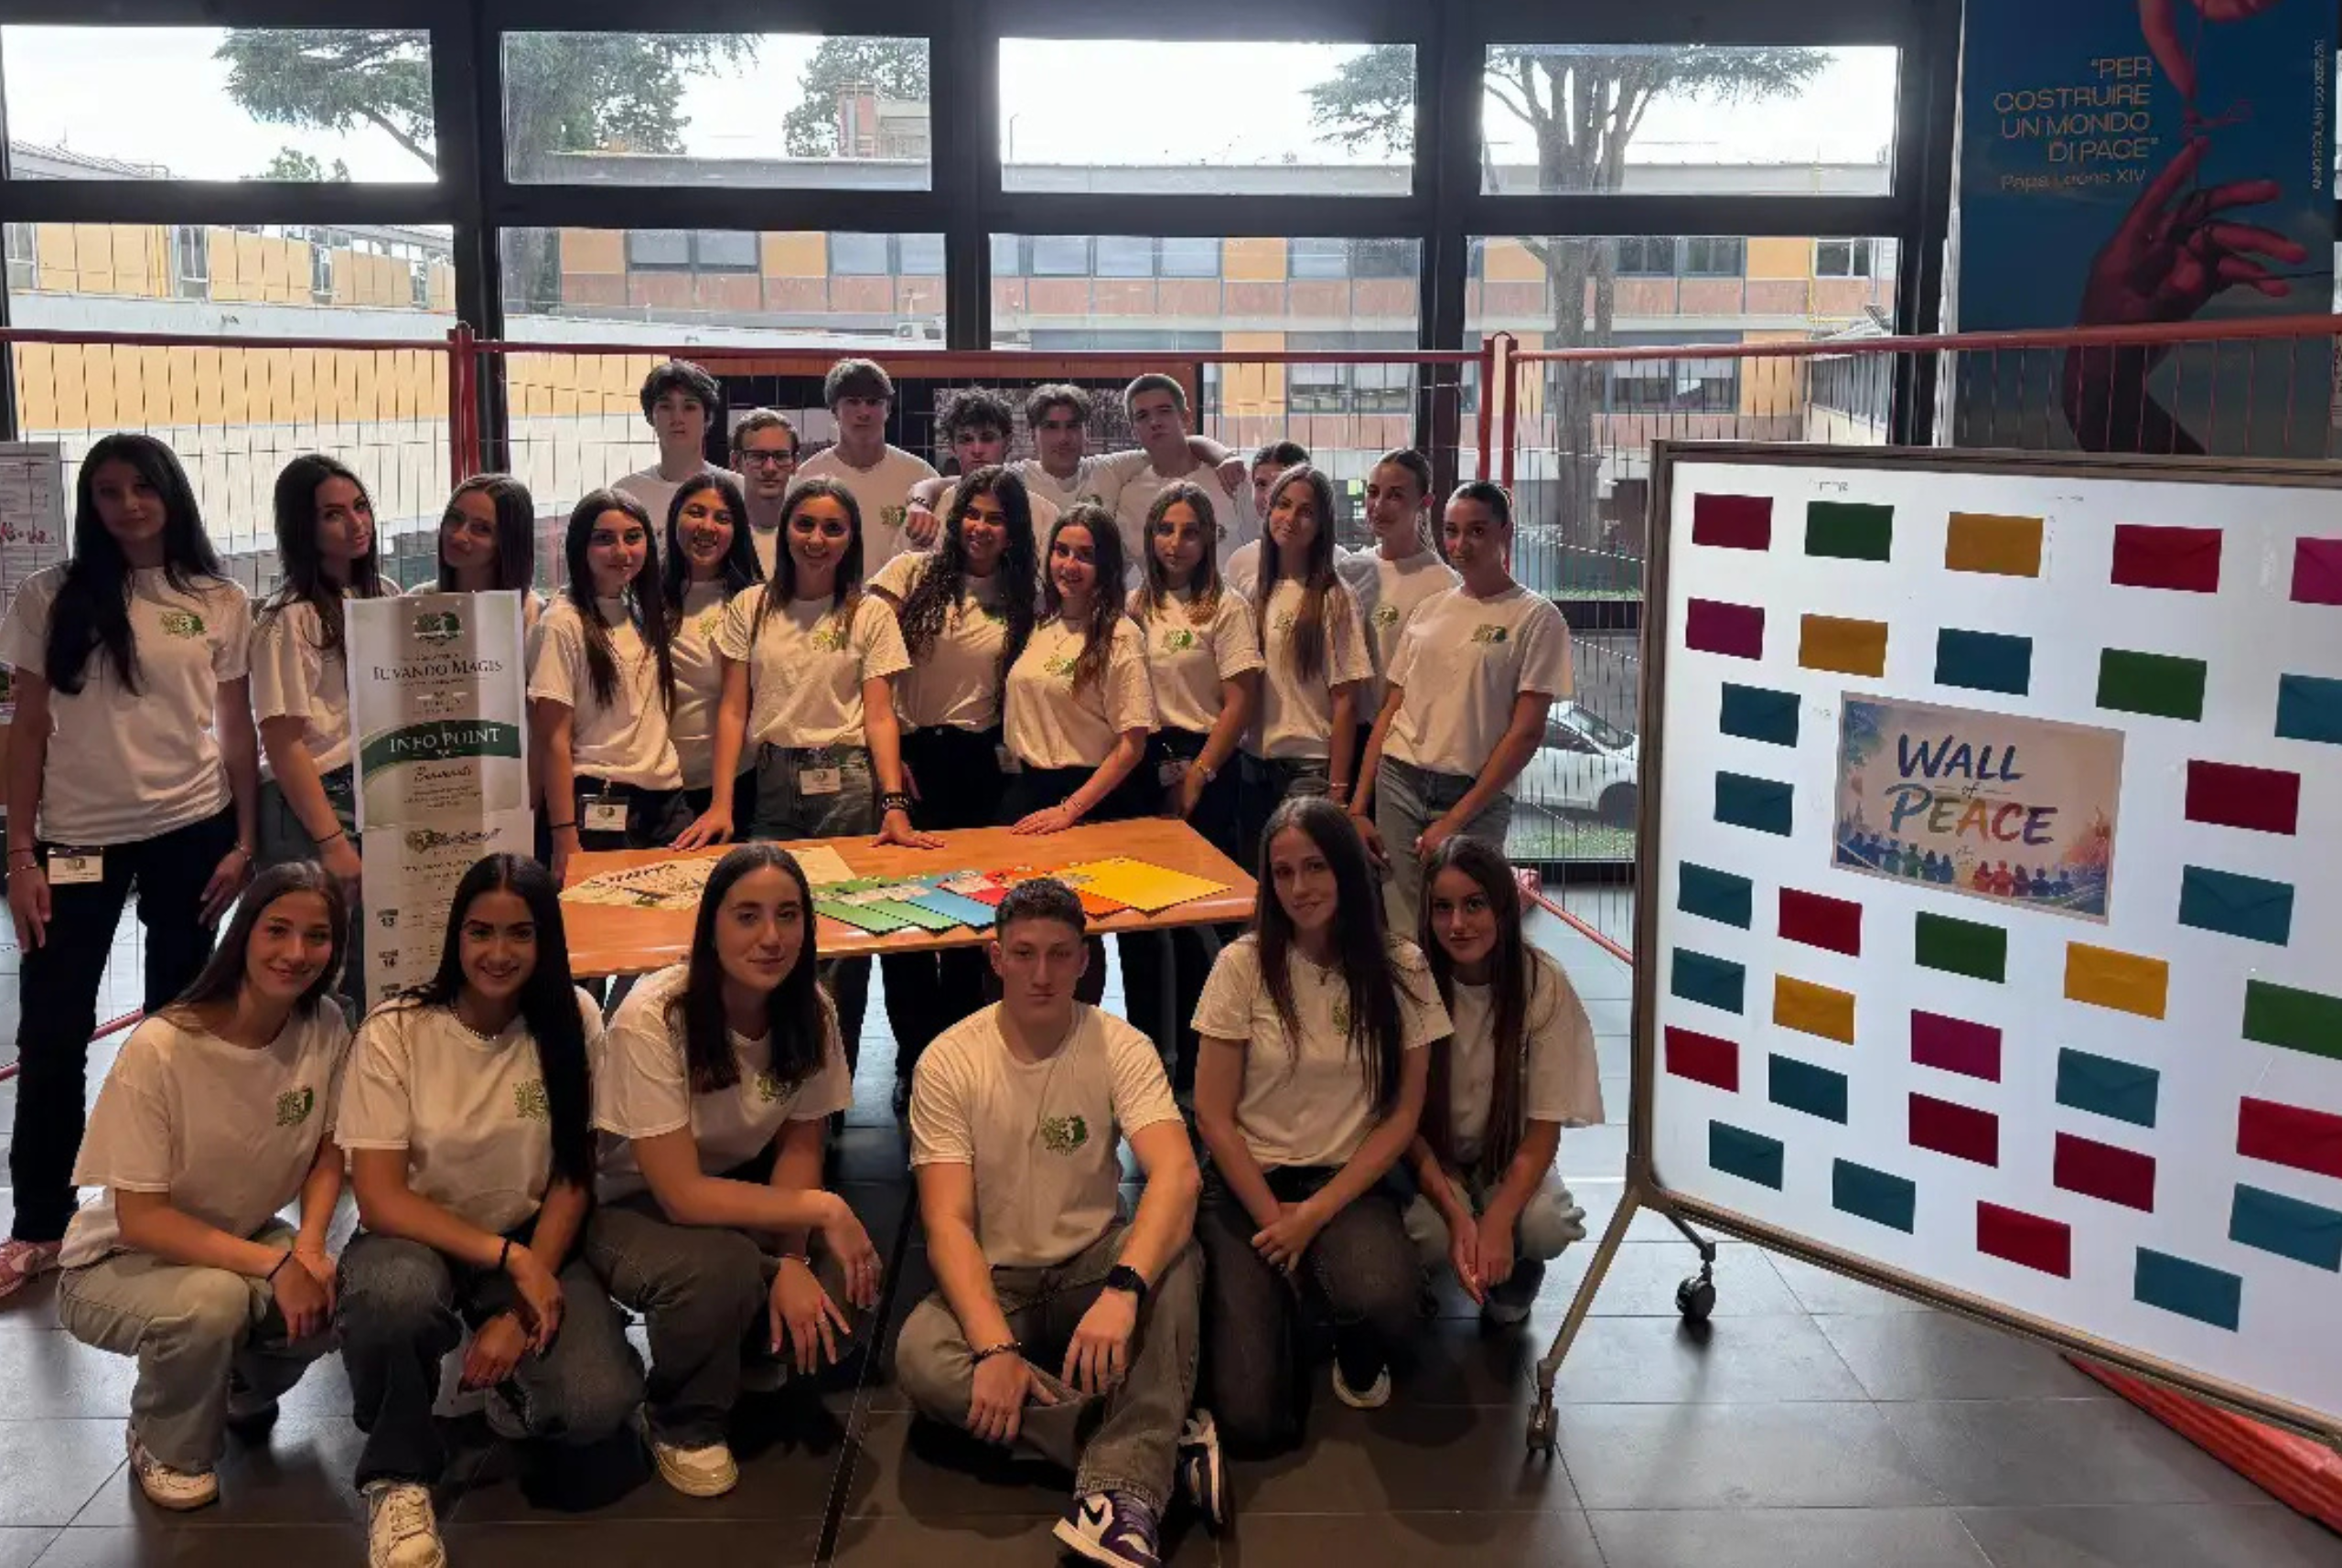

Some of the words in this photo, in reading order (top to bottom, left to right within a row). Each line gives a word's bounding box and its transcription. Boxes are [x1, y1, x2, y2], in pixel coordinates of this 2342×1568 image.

[1993, 83, 2153, 113] COSTRUIRE
[2001, 116, 2041, 139] UN
[2046, 112, 2150, 136] MONDO
[2048, 141, 2075, 163] DI
[2117, 167, 2147, 185] XIV
[390, 734, 437, 753] INFO
[441, 727, 500, 746] POINT
[1896, 732, 2025, 780] WALL
[1961, 780, 1982, 800] of
[1884, 782, 2058, 846] PEACE
[381, 917, 395, 928] 13
